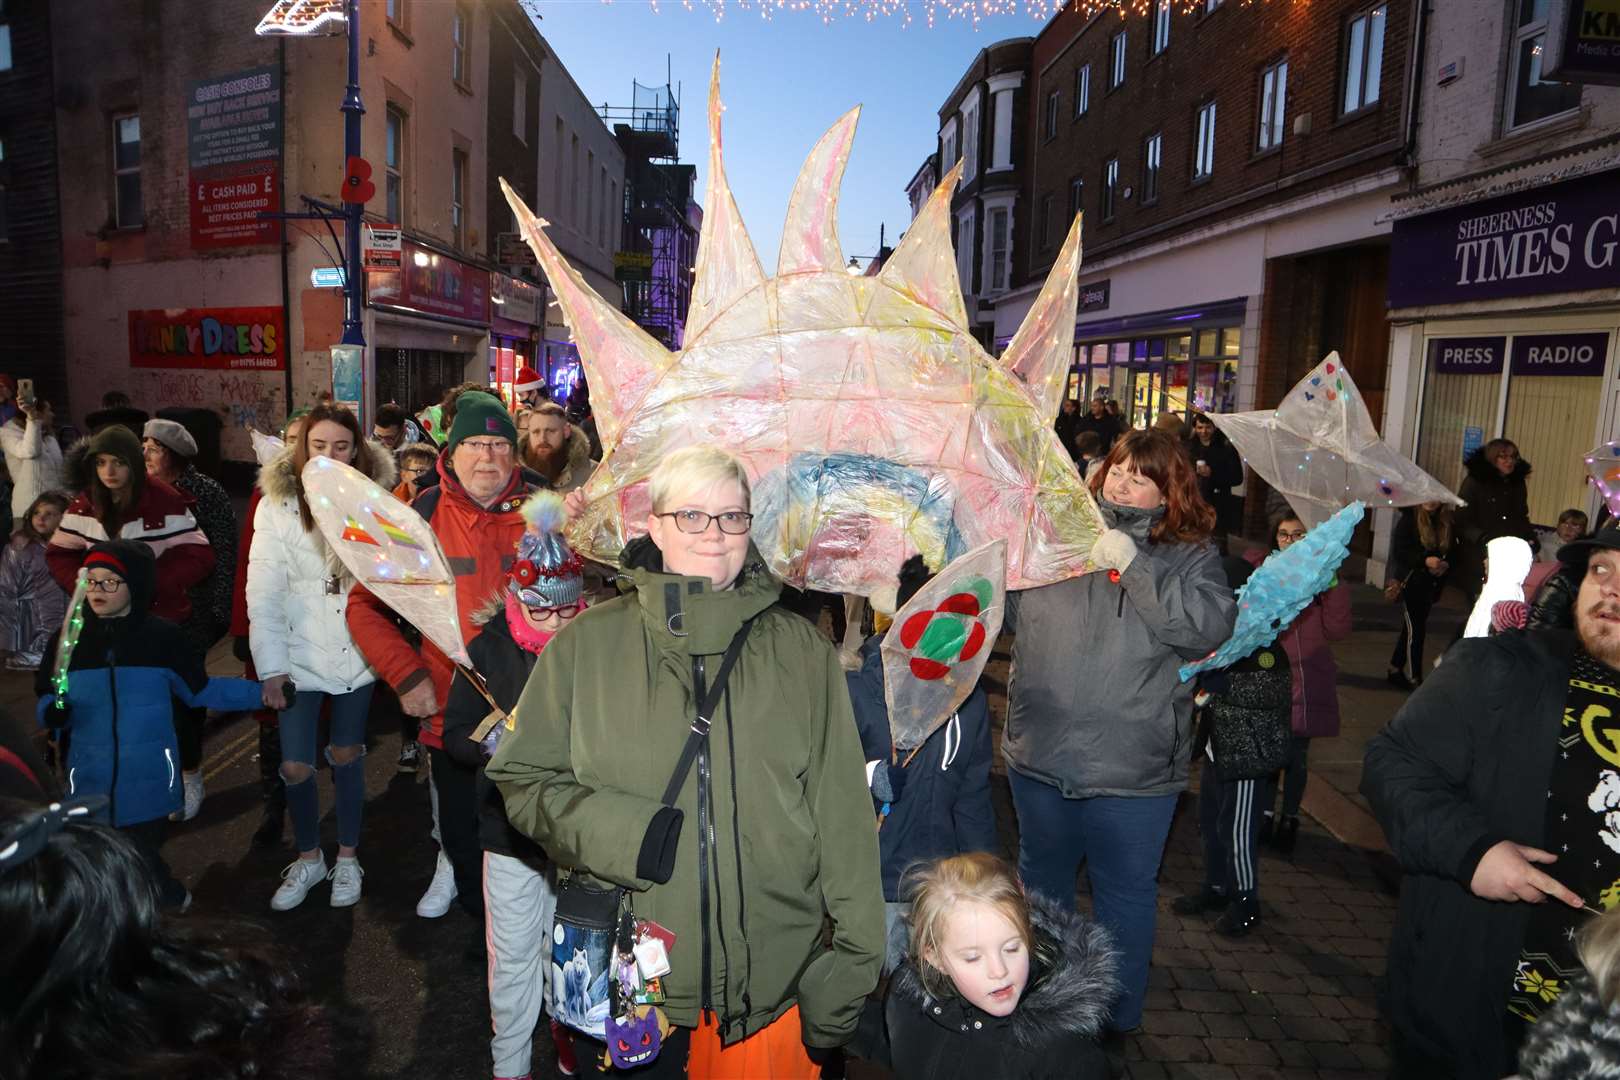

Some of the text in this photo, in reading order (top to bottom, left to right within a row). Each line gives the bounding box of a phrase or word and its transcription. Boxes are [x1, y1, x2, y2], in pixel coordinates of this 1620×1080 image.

[221, 73, 271, 97] CONSOLES
[197, 175, 273, 201] £ CASH PAID £
[202, 198, 269, 214] ALL ITEMS CONSIDERED
[208, 213, 222, 224] BEST
[222, 211, 242, 222] PRICES
[1458, 202, 1556, 240] SHEERNESS
[1455, 214, 1619, 285] TIMES G
[134, 317, 277, 354] FANCY DRESS
[1443, 345, 1594, 365] PRESS RADIO
